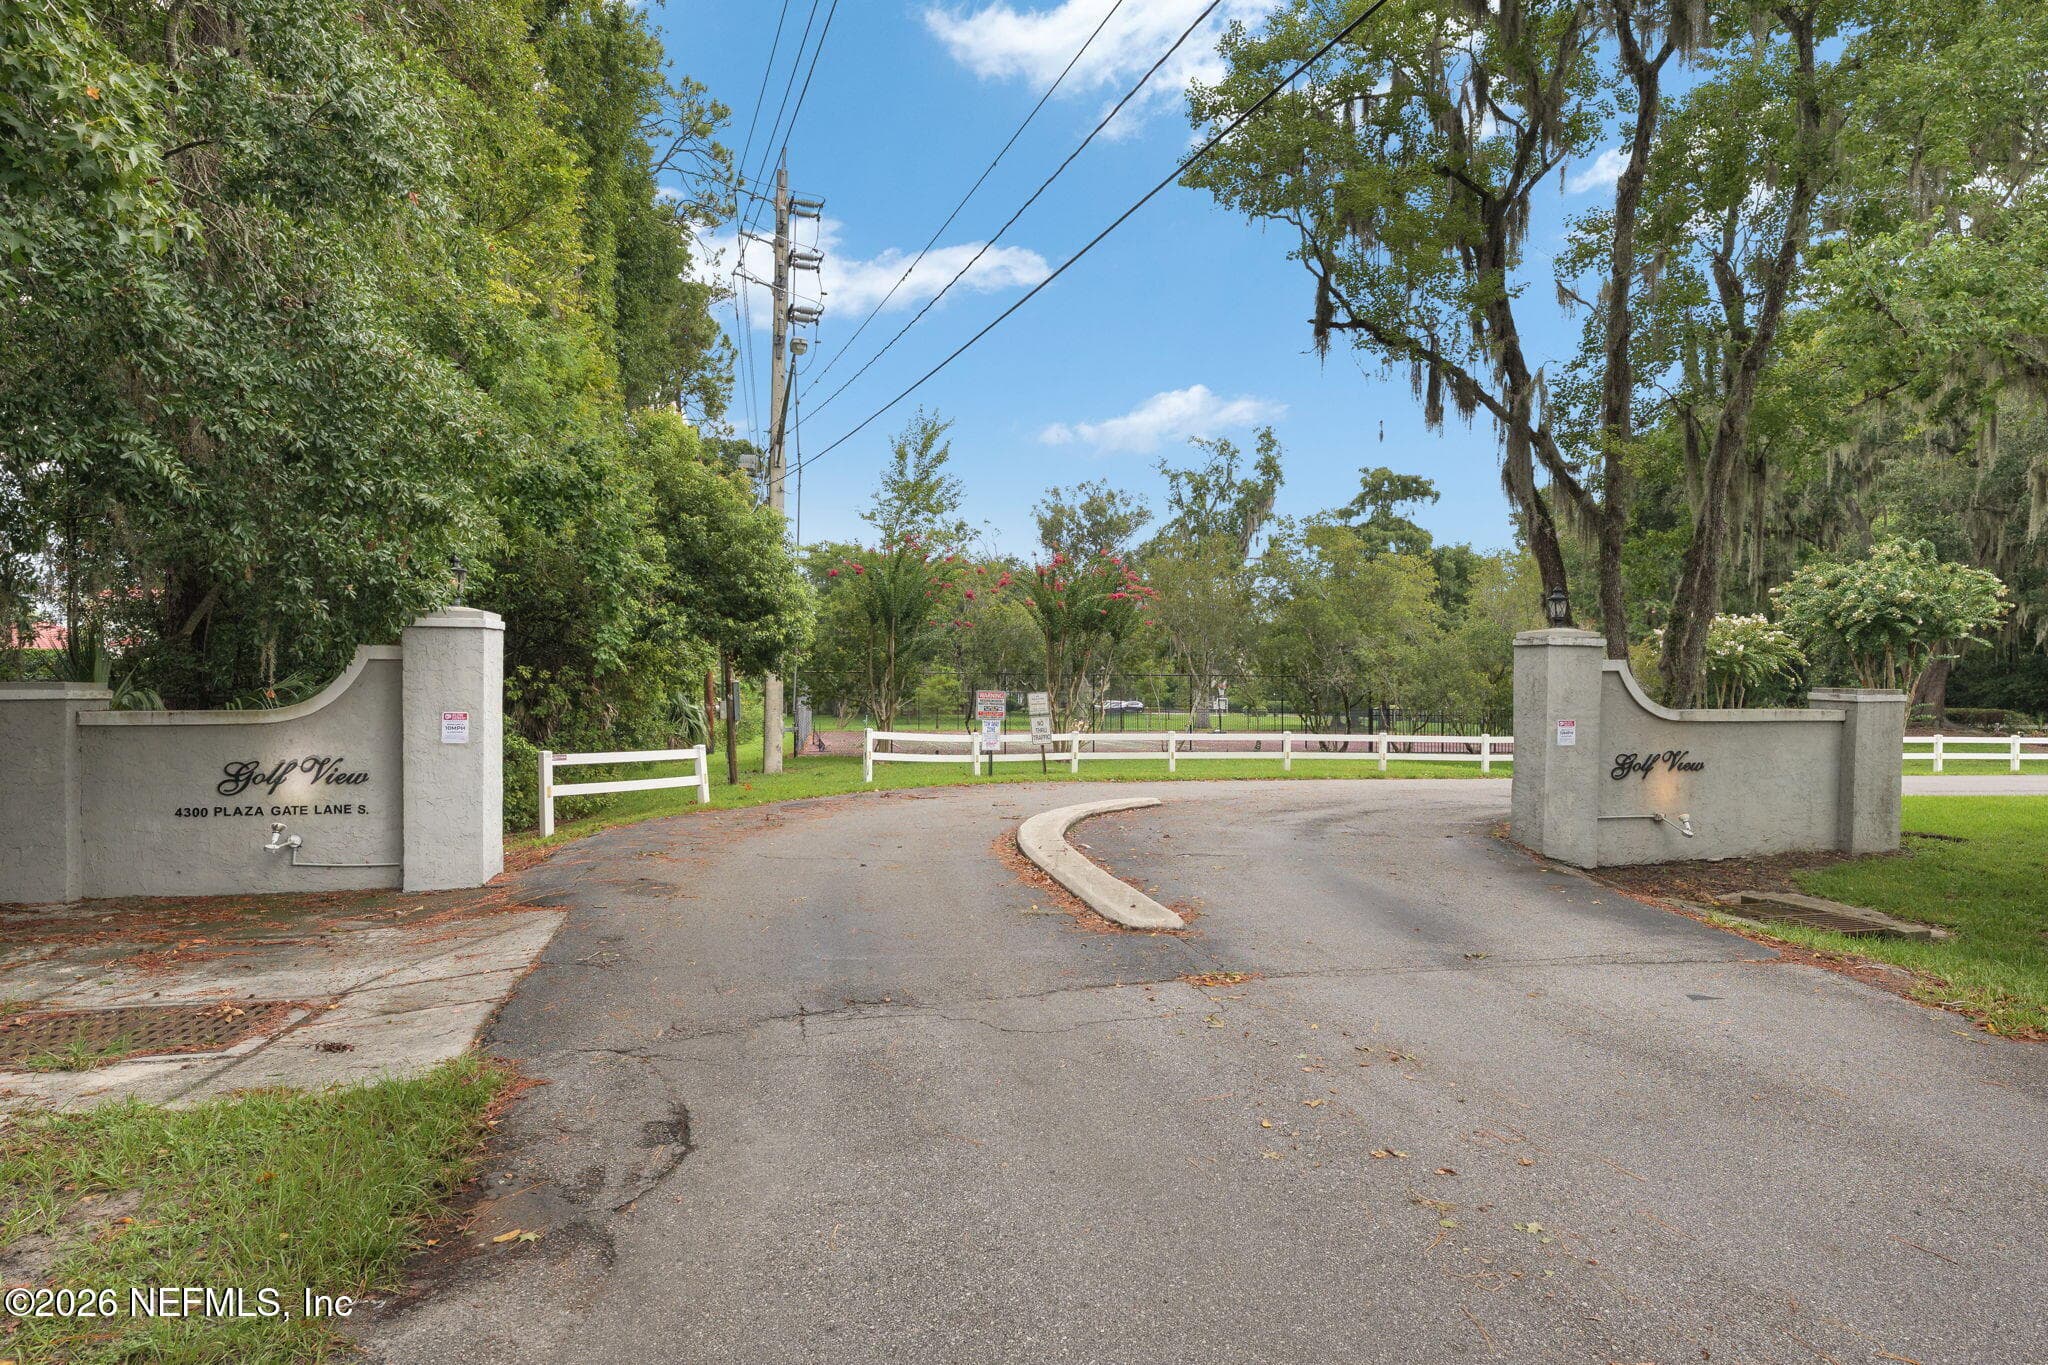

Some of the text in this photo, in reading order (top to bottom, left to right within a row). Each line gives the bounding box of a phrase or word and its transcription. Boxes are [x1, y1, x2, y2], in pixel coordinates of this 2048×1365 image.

[217, 754, 370, 797] Golf View
[1610, 750, 1705, 781] Golf View
[174, 804, 370, 818] 4300 PLAZA GATE LANE S.
